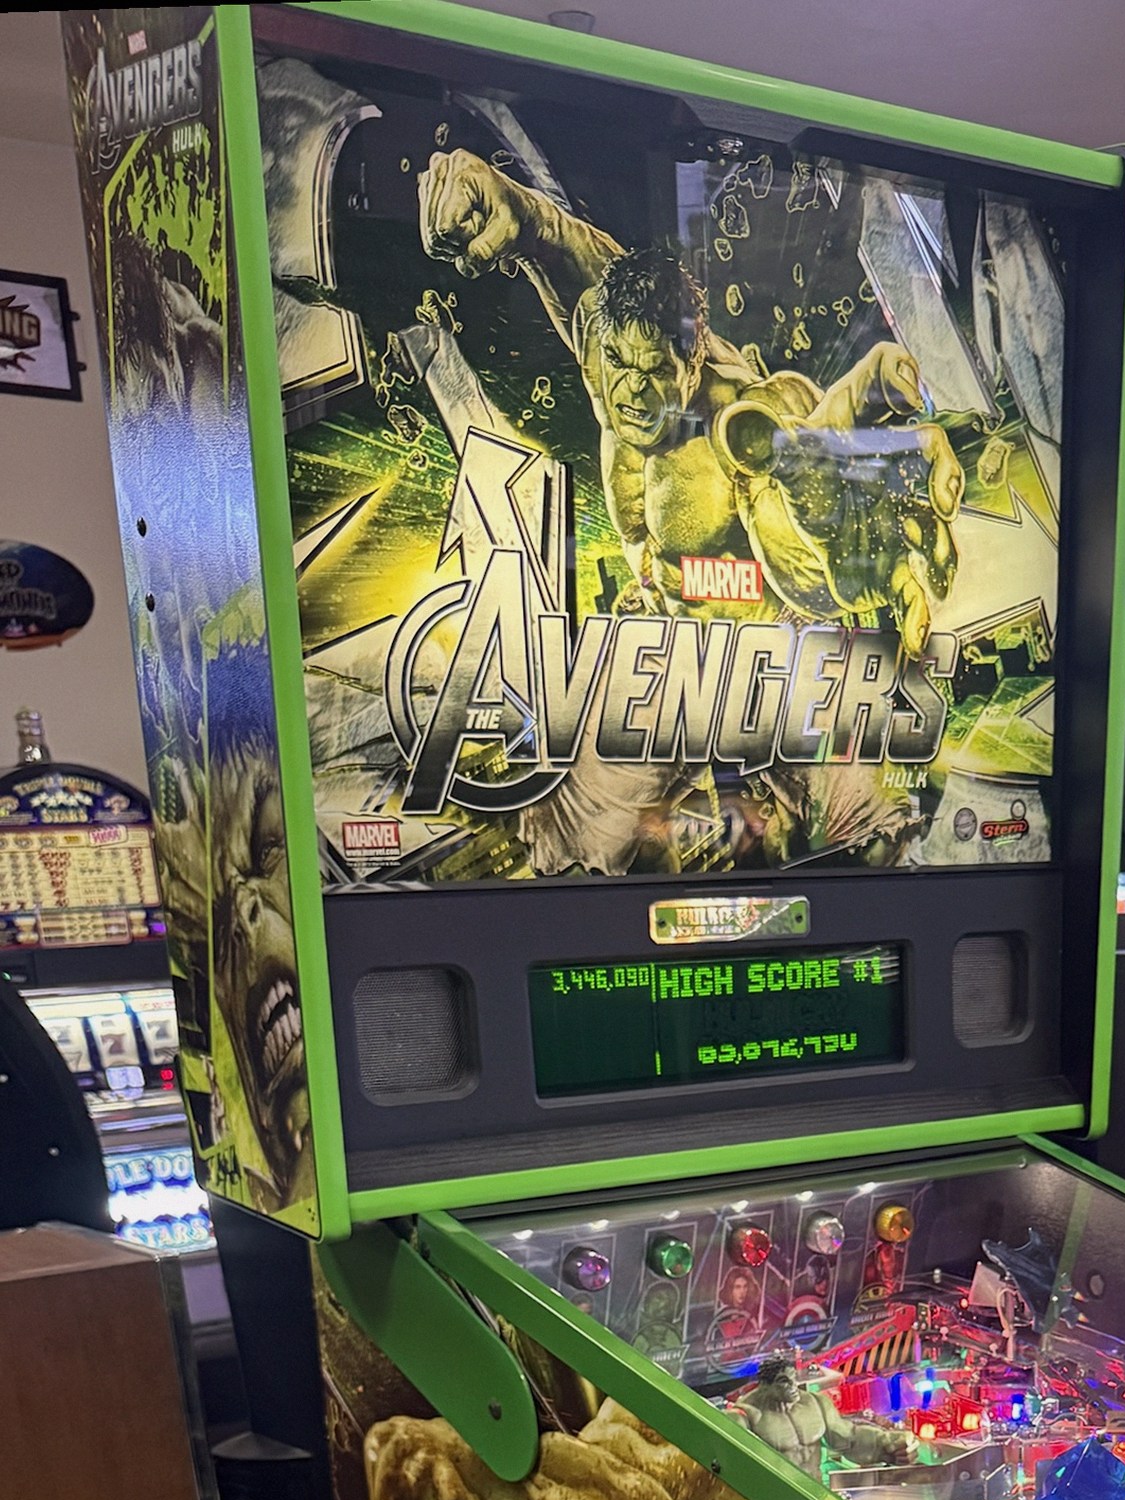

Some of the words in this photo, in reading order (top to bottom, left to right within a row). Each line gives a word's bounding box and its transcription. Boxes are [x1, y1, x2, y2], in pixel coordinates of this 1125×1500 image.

[86, 39, 202, 175] AVENGERS
[683, 559, 761, 601] MARVEL
[385, 548, 961, 816] AVENGERS
[465, 708, 502, 731] THE
[881, 771, 930, 789] HULK
[344, 823, 399, 848] MARVEL
[982, 822, 1027, 839] Stern
[552, 967, 650, 994] 3,446,090
[659, 965, 734, 998] HIGH
[748, 959, 841, 993] SCORE
[853, 956, 883, 985] #1
